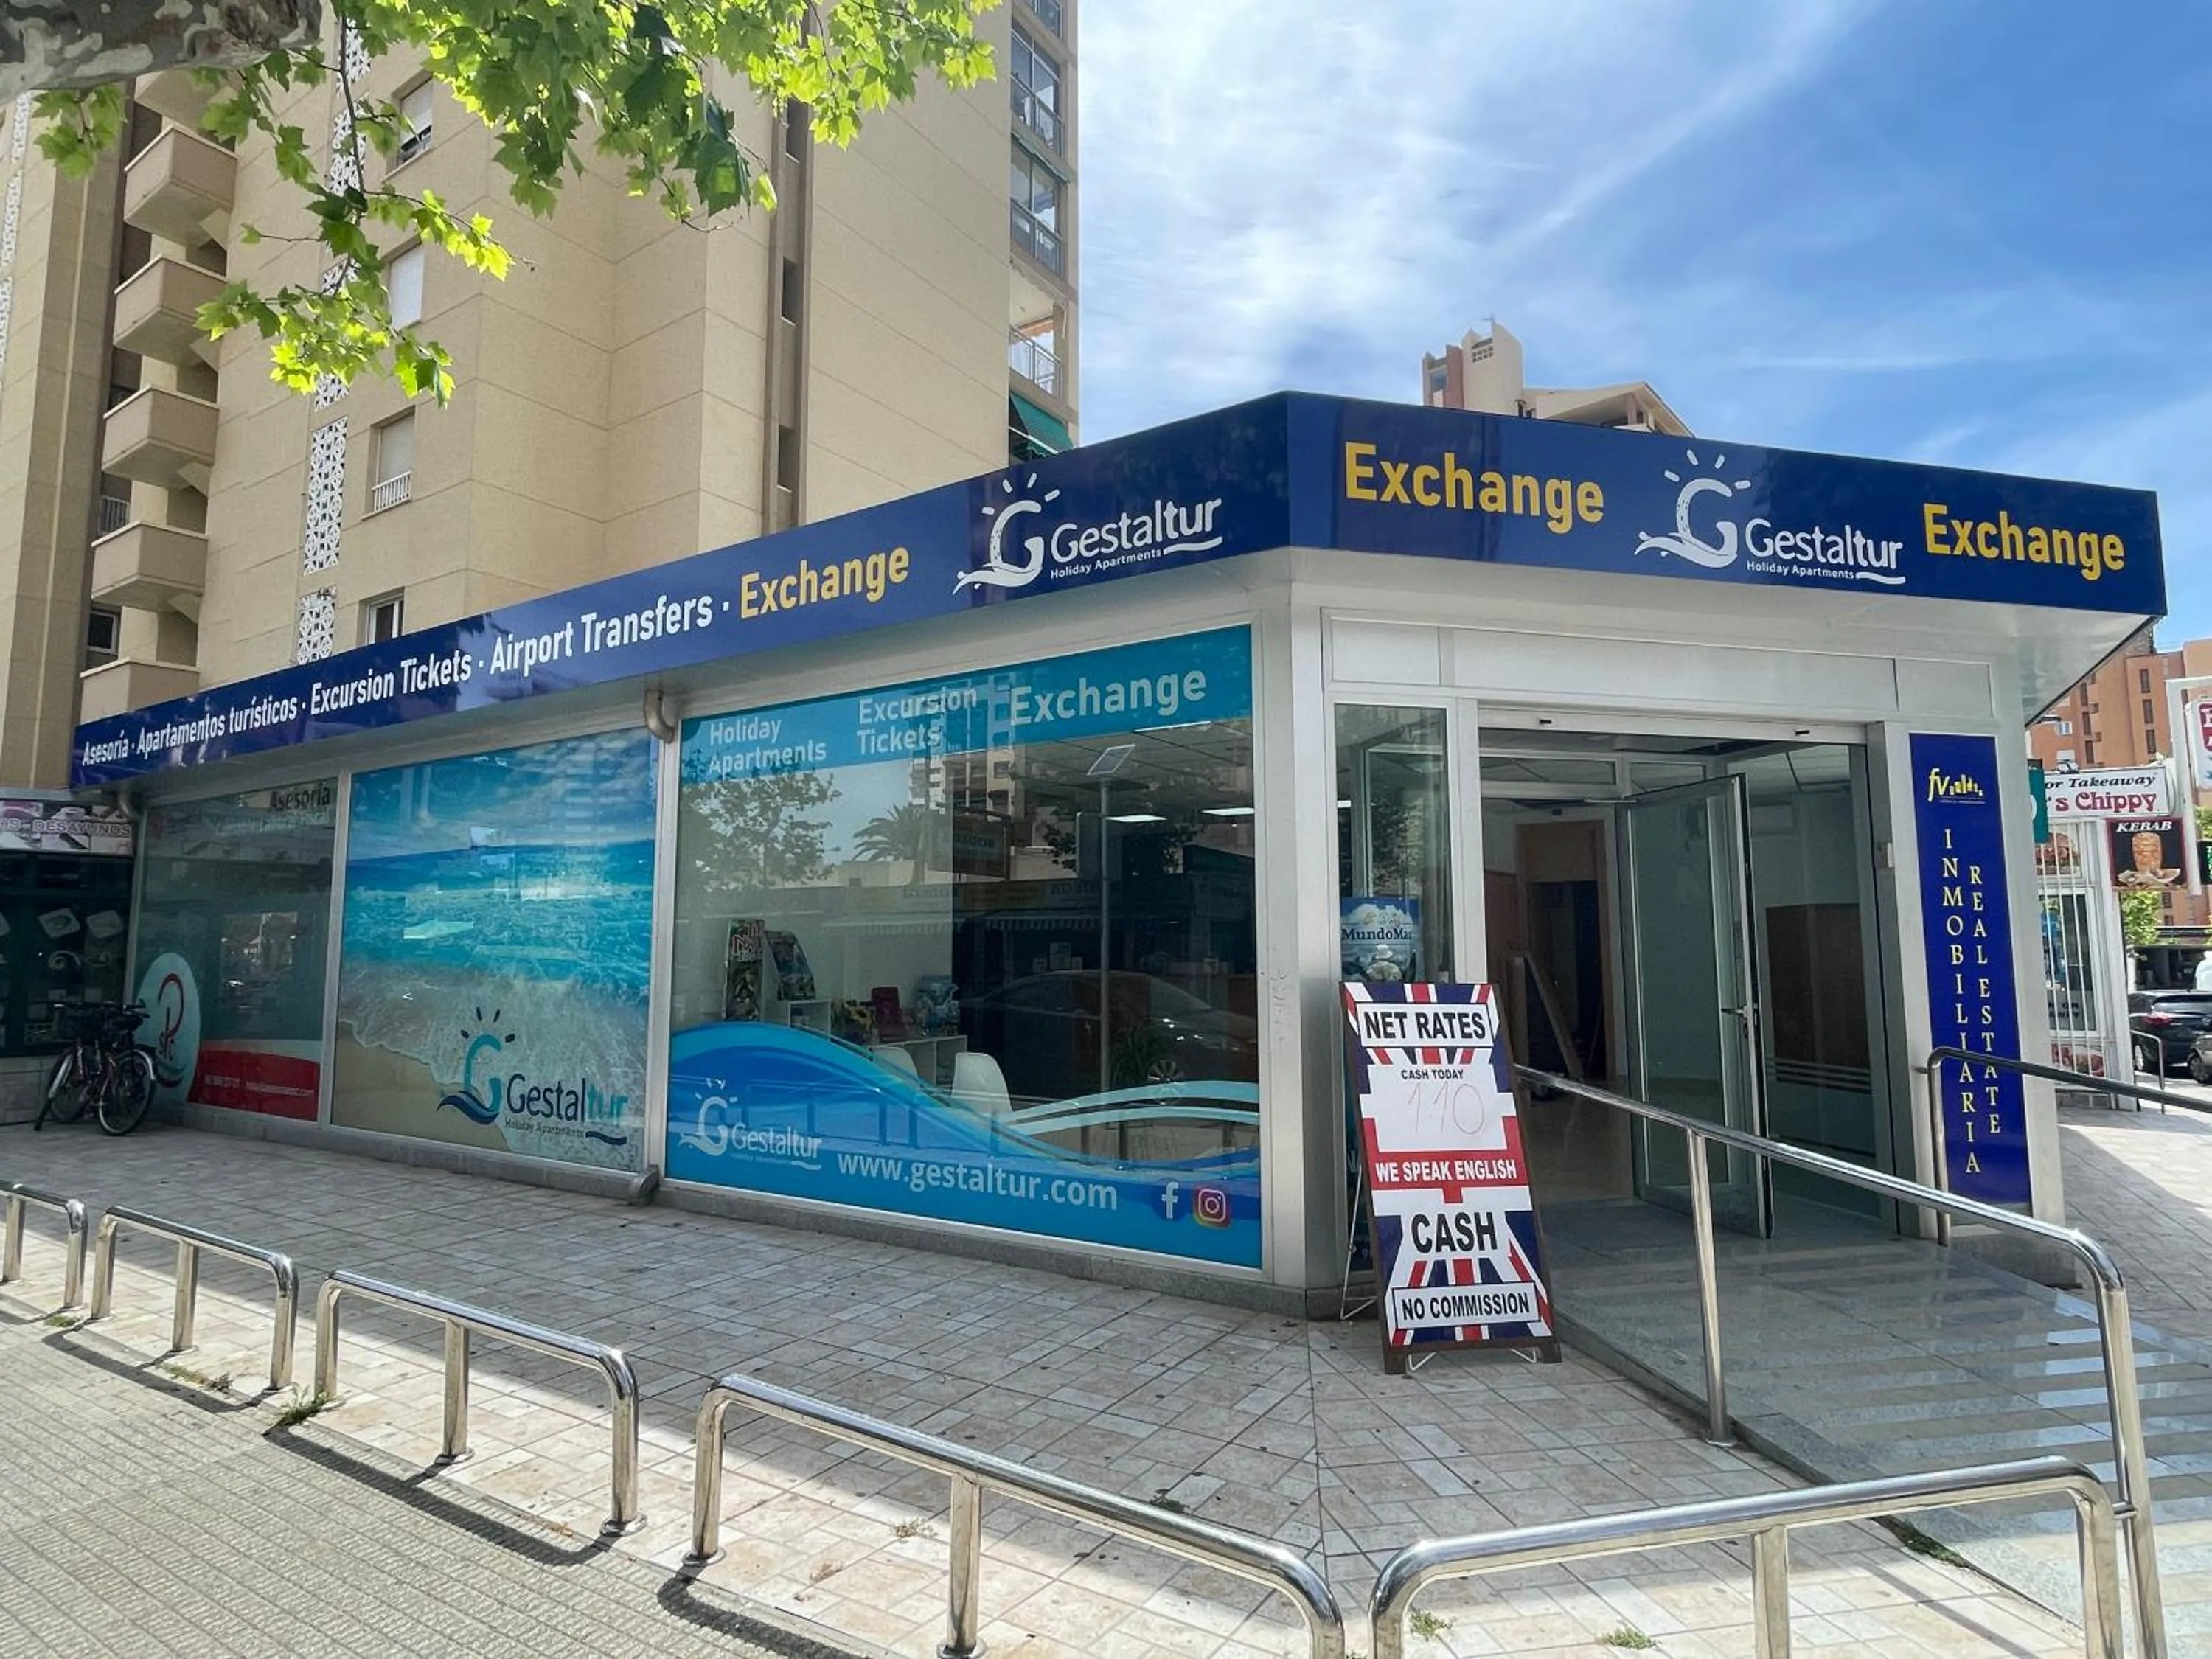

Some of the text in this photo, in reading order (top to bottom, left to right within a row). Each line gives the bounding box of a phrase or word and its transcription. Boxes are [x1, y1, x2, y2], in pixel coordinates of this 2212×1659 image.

[1346, 442, 1604, 535] Exchange
[1051, 498, 1222, 563] Gestaltur
[1745, 518, 1903, 571] Gestaltur
[1923, 503, 2125, 581] Exchange
[1051, 548, 1162, 580] Holiday Apartments
[1747, 560, 1855, 580] Holiday Apartments
[82, 546, 910, 767] Asesoría Apartamentos turísticos Excursion Tickets Airport Transfers Exchange
[858, 685, 978, 726] Excursion
[1010, 670, 1208, 726] Exchange
[709, 717, 782, 747] Holiday
[858, 724, 942, 755] Tickets
[709, 740, 827, 775] Apartments
[2069, 774, 2156, 788] Takeaway
[2076, 792, 2157, 813] Chippy
[2116, 821, 2173, 833] KEBAB
[1969, 866, 1989, 964] REAL
[1942, 829, 1982, 1174] INMOBILIARIA
[1364, 1011, 1486, 1040] NET RATES
[1402, 1069, 1464, 1080] CASH TODAY
[1978, 978, 2000, 1134] ESTATE
[507, 1072, 629, 1123] Gestaltur
[1408, 1081, 1485, 1135] 110
[731, 1123, 823, 1159] Gestaltur
[838, 1154, 1119, 1211] www.gestaltur.com
[1375, 1158, 1517, 1183] WE SPEAK ENGLISH
[1411, 1211, 1498, 1254] CASH
[1402, 1292, 1530, 1321] NO COMMISSION
